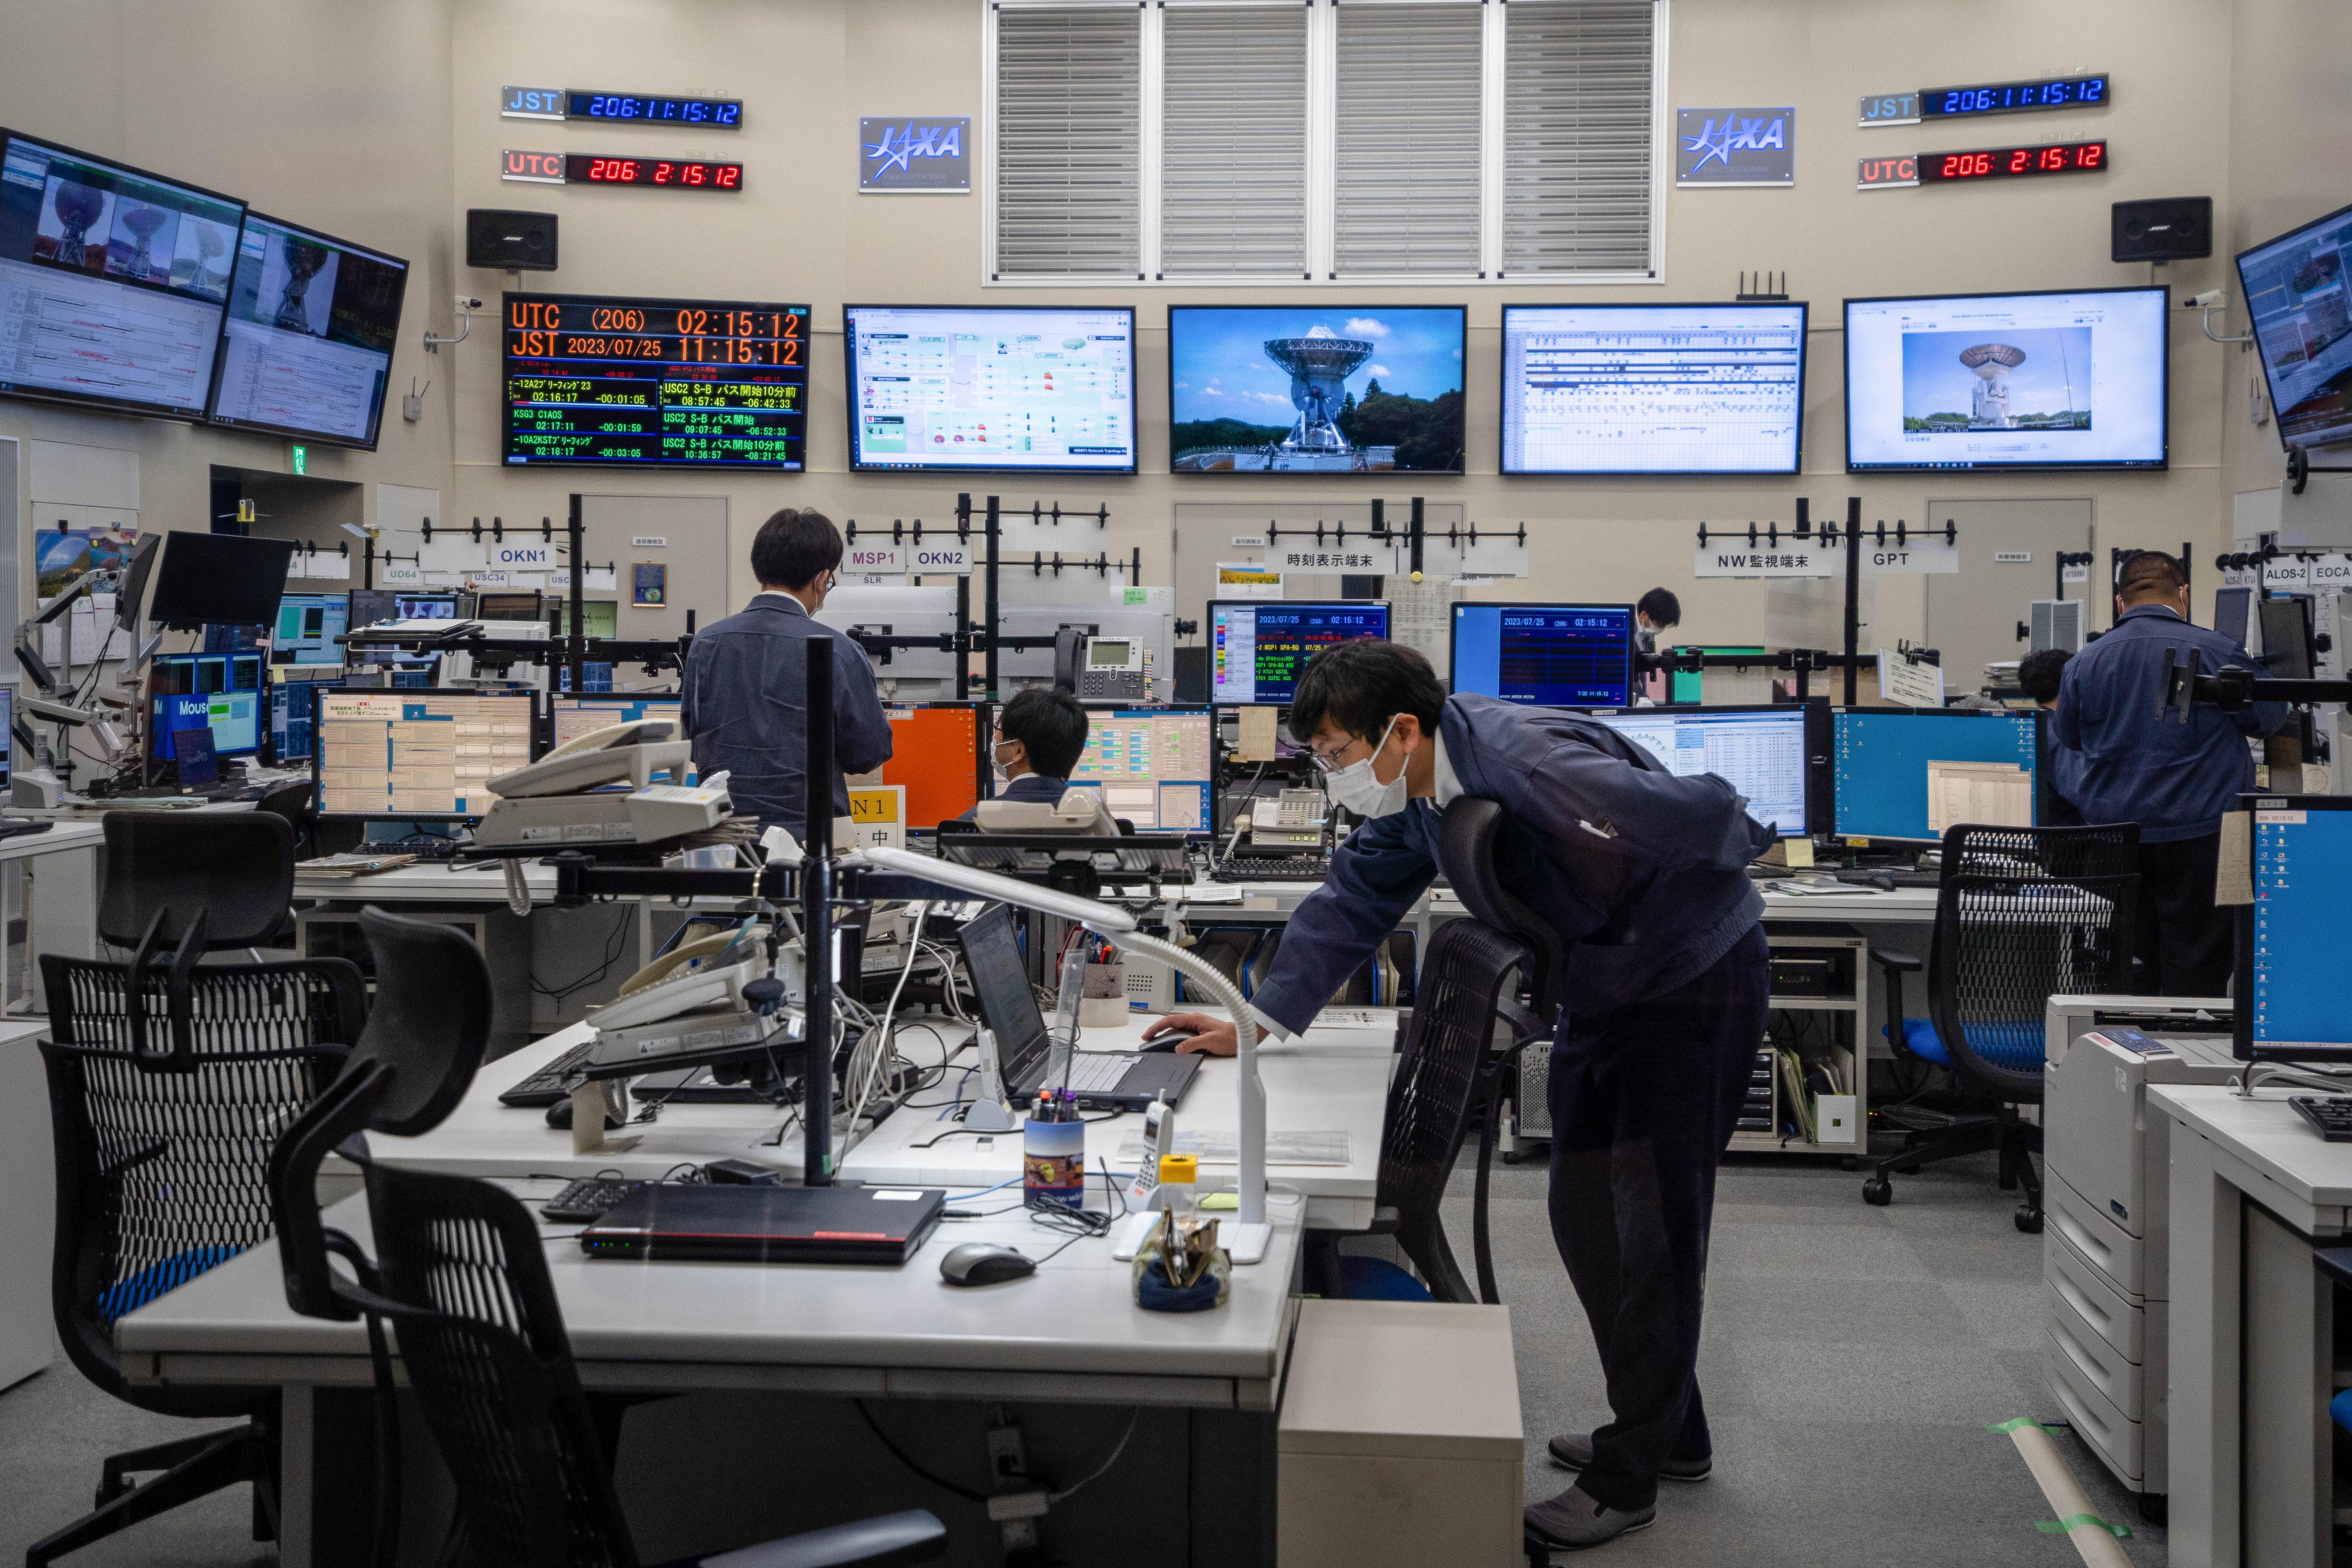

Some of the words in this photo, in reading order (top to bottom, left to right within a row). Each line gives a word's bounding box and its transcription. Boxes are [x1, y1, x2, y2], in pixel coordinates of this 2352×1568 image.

[510, 91, 557, 112] JST
[1867, 97, 1913, 118] JST
[1681, 112, 1784, 174] JAXA
[863, 120, 961, 180] JAXA
[509, 154, 559, 175] UTC
[1864, 159, 1913, 180] UTC
[512, 303, 559, 328] UTC
[592, 308, 644, 332] (206)
[678, 310, 798, 338] 02:15:12
[512, 331, 558, 356] JST
[568, 338, 661, 357] 2023/07/25
[680, 337, 797, 364] 11:15:12
[665, 383, 688, 393] USC2
[694, 384, 711, 394] S-B
[717, 384, 796, 398] パス開始10分前
[532, 392, 577, 402] 02:16:17
[595, 395, 645, 405] -00:01:05
[682, 397, 725, 406] 08:57:45
[742, 399, 790, 408] -06:42:33
[664, 413, 685, 422] USC2
[691, 414, 707, 423] S-B
[712, 414, 754, 425] パス開始
[536, 422, 573, 430] 02:17:11
[599, 423, 641, 432] -00:01:59
[745, 427, 786, 436] -06:52:33
[663, 438, 685, 447] USC2
[690, 439, 706, 448] S-B
[711, 439, 785, 451] パス開始10分前
[536, 447, 574, 456] 02:18:17
[598, 448, 641, 457] -00:03:05
[685, 450, 721, 459] 10:36:57
[745, 452, 786, 461] -08:21:45
[501, 549, 546, 562] OKN1
[853, 552, 894, 564] MSP1
[918, 552, 962, 564] OKN2
[1287, 554, 1373, 567] 時刻表示端末
[1874, 553, 1909, 565] GPT
[390, 570, 416, 579] UD64
[475, 573, 505, 581] USC34
[2266, 568, 2305, 579] ALOS-2
[1259, 615, 1299, 624] 2023/07/25
[1331, 616, 1363, 624] 02:15:12
